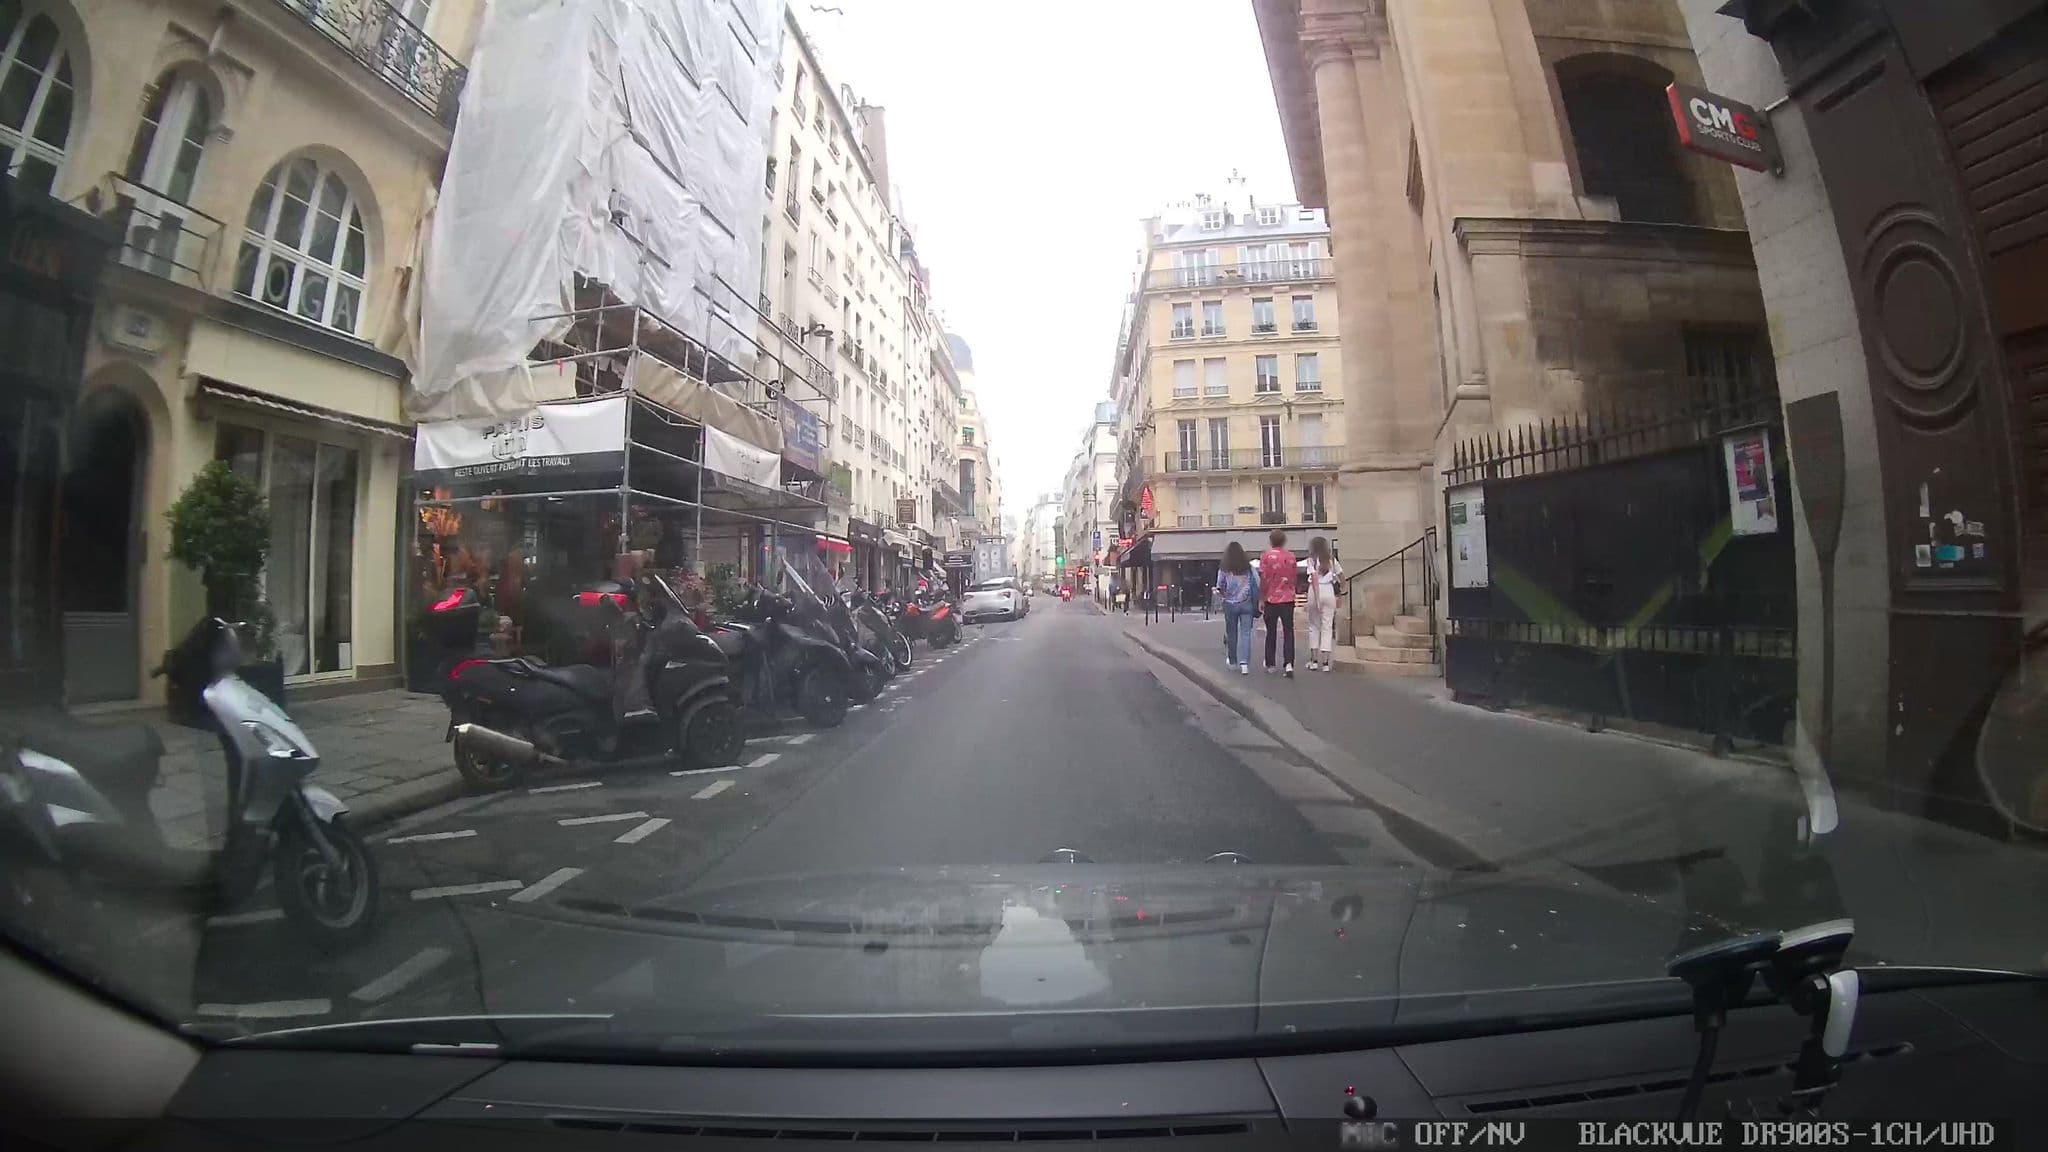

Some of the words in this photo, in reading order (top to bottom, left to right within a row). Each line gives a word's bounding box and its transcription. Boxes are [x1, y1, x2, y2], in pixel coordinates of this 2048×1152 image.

[1690, 98, 1757, 140] CMG
[473, 463, 498, 475] OUVERT
[528, 457, 541, 468] LES
[542, 455, 571, 467] TRAVAUX
